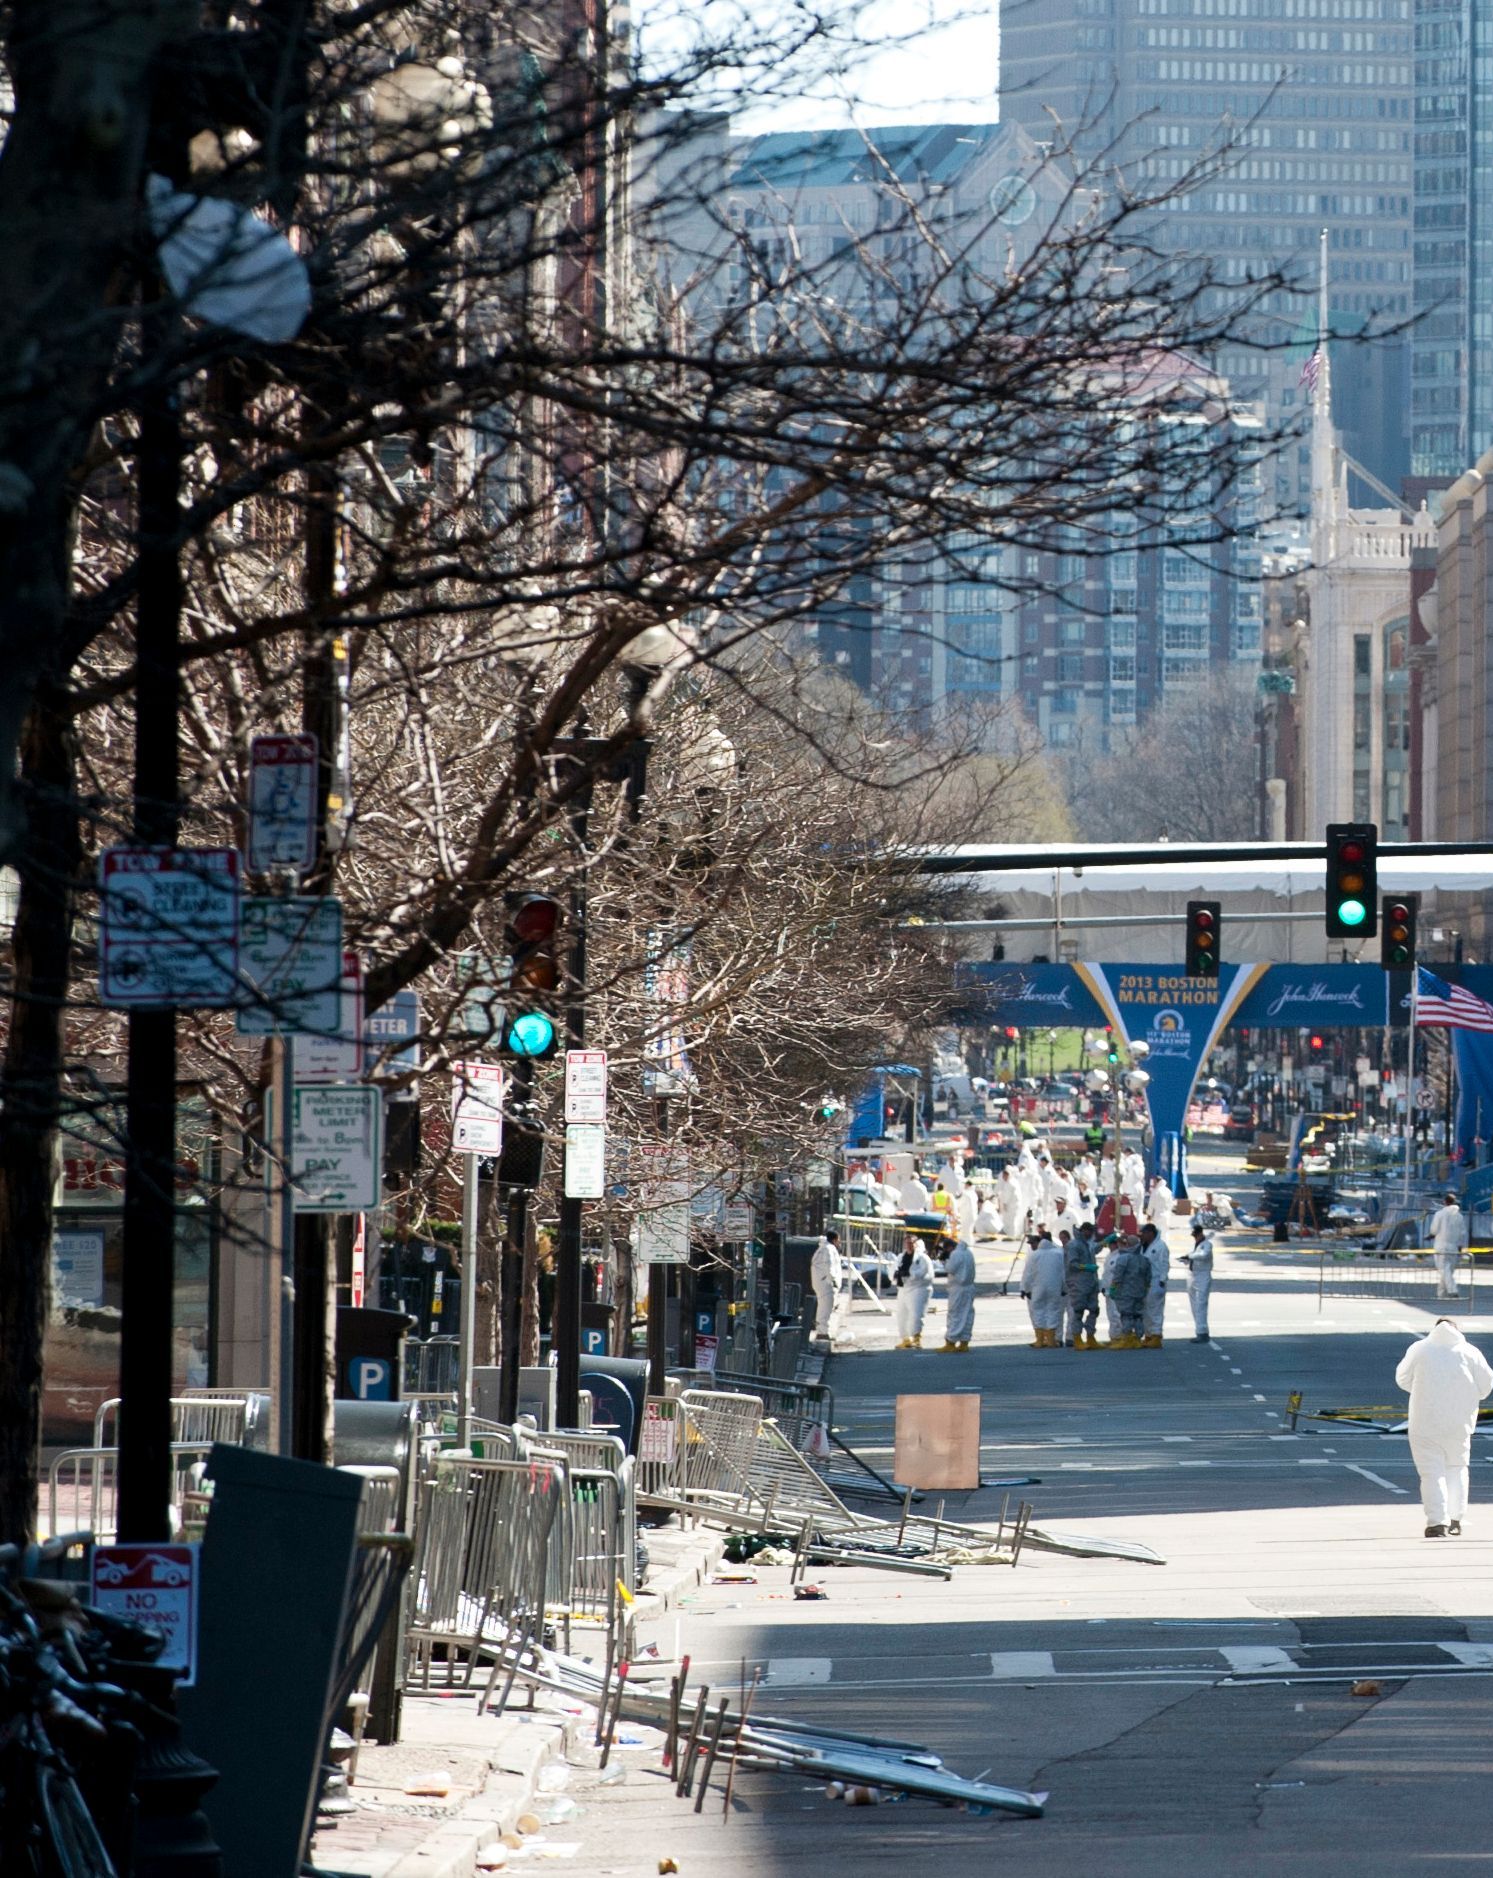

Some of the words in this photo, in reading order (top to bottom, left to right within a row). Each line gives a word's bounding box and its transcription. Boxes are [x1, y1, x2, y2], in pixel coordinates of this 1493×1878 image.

[112, 854, 159, 872] TOW
[1119, 975, 1152, 989] 2013
[1158, 976, 1217, 989] BOSTON
[1119, 990, 1218, 1004] MARATHON
[312, 1107, 367, 1116] METER
[319, 1117, 357, 1127] LIMIT
[305, 1159, 341, 1170] PAY
[698, 1315, 710, 1331] P
[588, 1332, 601, 1352] P
[358, 1362, 384, 1399] P
[125, 1593, 156, 1610] NO
